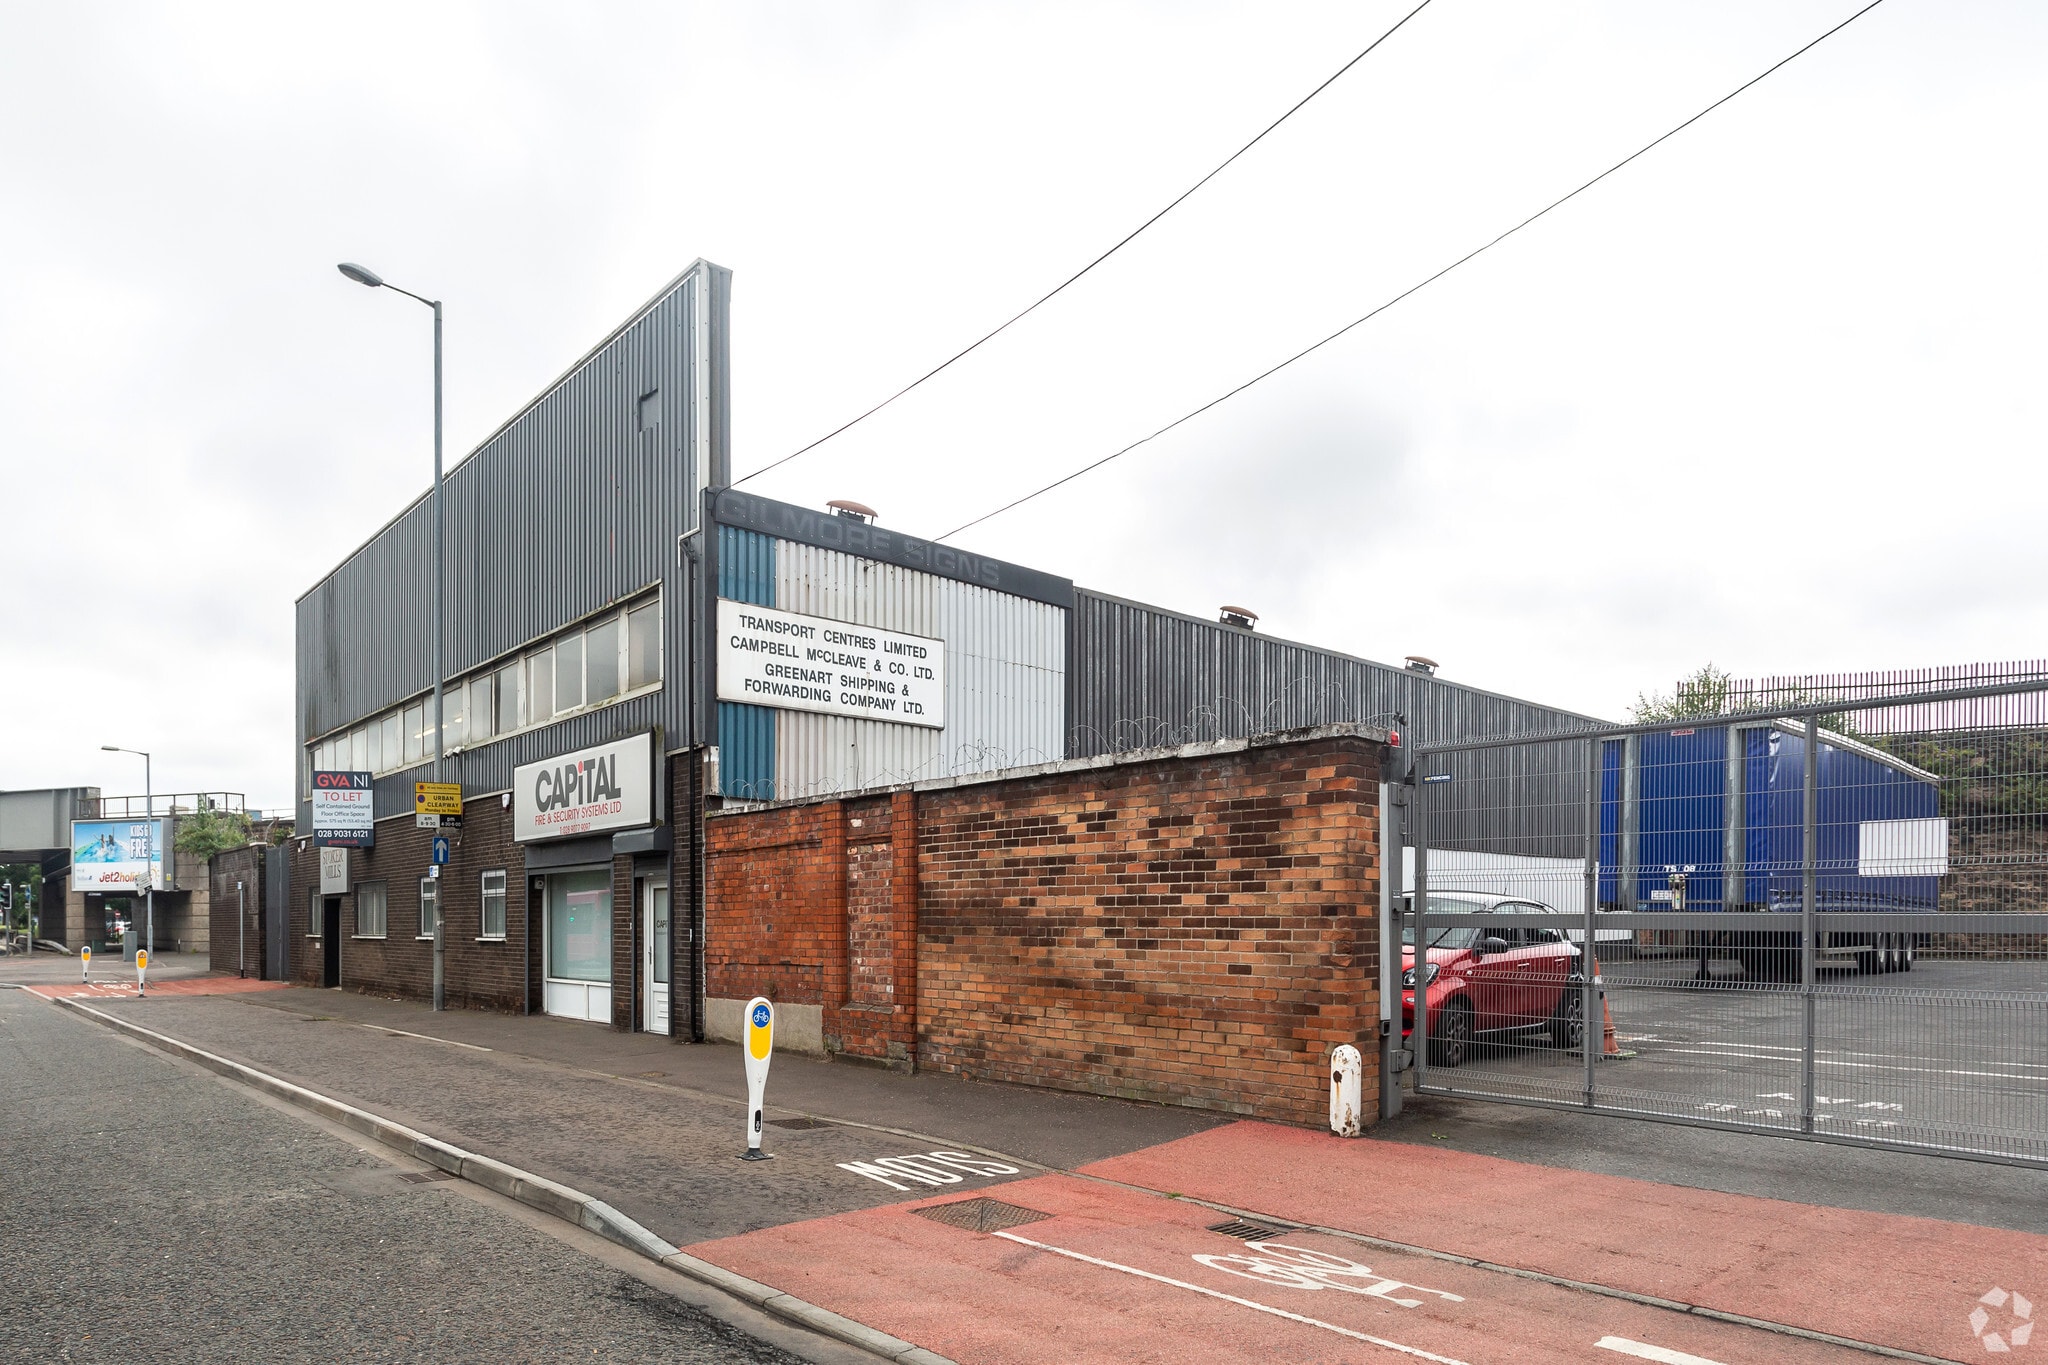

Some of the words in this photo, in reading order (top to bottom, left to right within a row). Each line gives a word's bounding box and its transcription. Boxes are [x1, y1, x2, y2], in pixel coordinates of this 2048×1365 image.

[716, 494, 891, 555] GILMORE
[903, 537, 999, 586] SIGNS
[739, 614, 816, 640] TRANSPORT
[823, 630, 876, 651] CENTRES
[884, 640, 928, 660] LIMITED
[730, 635, 800, 659] CAMPBELL
[806, 647, 867, 670] McCLEAVE
[873, 658, 882, 672] &
[889, 661, 909, 677] CO.
[913, 665, 935, 681] LTD.
[744, 678, 832, 702] FORWARDING
[840, 692, 896, 711] COMPANY
[903, 699, 925, 715] LTD.
[765, 663, 833, 685] GREENART
[840, 674, 896, 695] SHIPPING
[901, 684, 910, 697] &
[317, 773, 351, 788] GVA
[353, 774, 368, 788] NI
[323, 791, 339, 802] TO
[342, 792, 363, 802] LET
[535, 813, 546, 826] FIRE
[547, 813, 553, 824] &
[553, 807, 580, 823] SECURITY
[581, 802, 609, 819] SYSTEMS
[610, 800, 622, 814] LTD
[317, 830, 332, 838] 028
[334, 830, 351, 838] 9031
[352, 830, 368, 838] 6121
[836, 1151, 1020, 1191] SLOW
